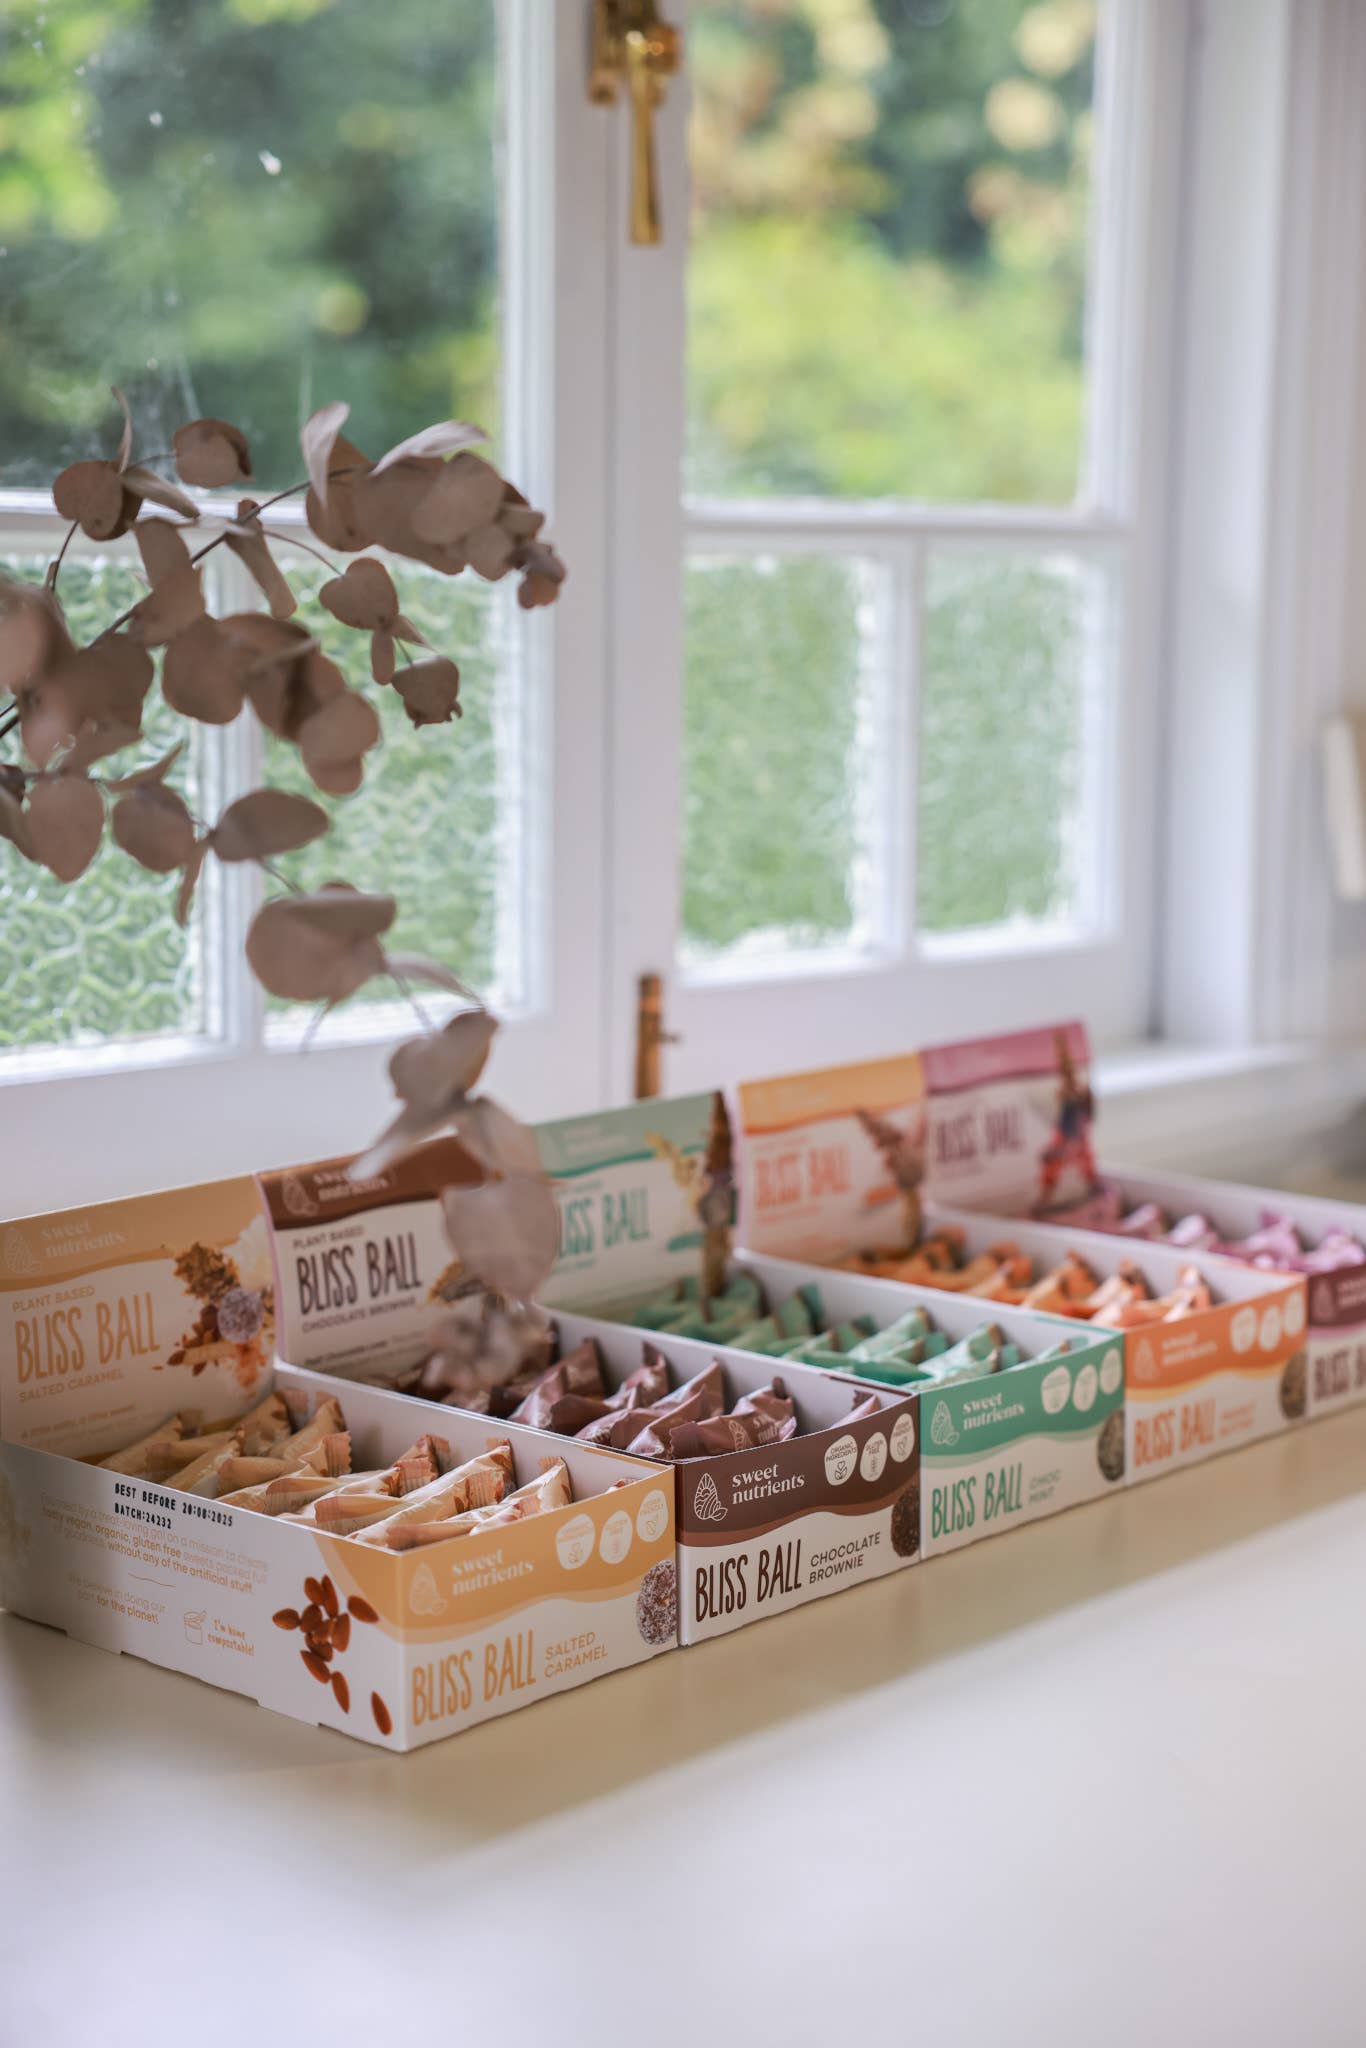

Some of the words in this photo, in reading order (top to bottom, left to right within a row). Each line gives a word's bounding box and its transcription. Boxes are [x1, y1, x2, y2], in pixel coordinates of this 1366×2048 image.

[40, 1219, 92, 1240] sweet
[46, 1229, 129, 1259] nutrients
[296, 1245, 358, 1316] BLISS
[367, 1231, 422, 1299] BALL
[12, 1293, 52, 1313] PLANT
[54, 1284, 96, 1305] BASED
[15, 1305, 85, 1385] BLISS
[96, 1290, 161, 1366] BALL
[18, 1381, 65, 1403] SALTED
[68, 1368, 125, 1392] CARAMEL
[962, 1392, 1003, 1415] sweet
[963, 1402, 1026, 1431] nutrients
[731, 1462, 781, 1489] sweet
[732, 1473, 806, 1506] nutrients
[113, 1502, 173, 1530] BATCH:24232
[114, 1482, 137, 1499] BEST
[141, 1490, 177, 1511] BEFORE
[181, 1502, 234, 1528] 20:08:2025
[931, 1475, 977, 1540] BLISS
[983, 1461, 1023, 1522] BALL
[95, 1524, 131, 1546] organic,
[132, 1535, 161, 1549] gluten
[163, 1544, 181, 1558] free
[106, 1540, 141, 1559] without
[142, 1551, 159, 1567] any
[161, 1557, 171, 1568] of
[172, 1560, 188, 1574] the
[810, 1531, 881, 1568] CHOCOLATE
[451, 1548, 505, 1576] sweet
[452, 1560, 535, 1596] nutrients
[808, 1553, 865, 1586] BROWNIE
[694, 1553, 749, 1623] BLISS
[756, 1538, 802, 1603] BALL
[111, 1598, 126, 1613] the
[543, 1644, 609, 1679] CARAMEL
[545, 1631, 597, 1661] SALTED
[411, 1648, 473, 1727] BLISS
[483, 1629, 537, 1703] BALL
